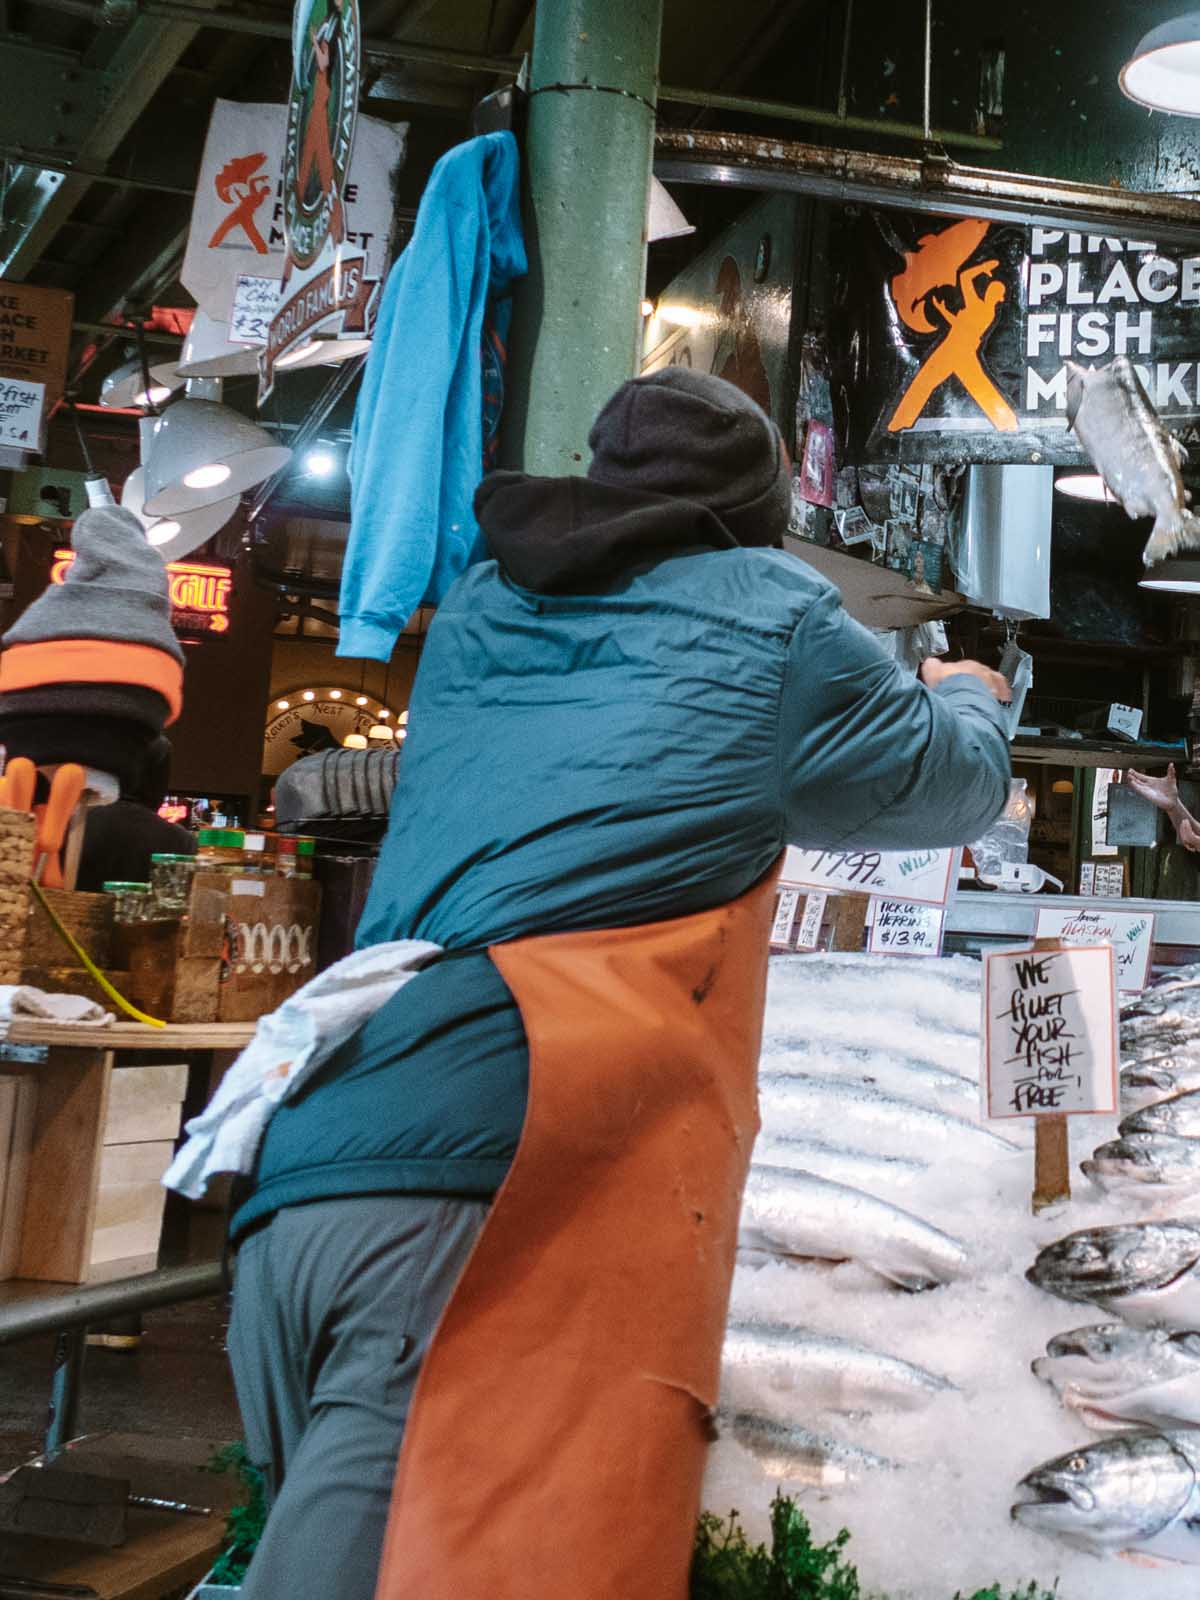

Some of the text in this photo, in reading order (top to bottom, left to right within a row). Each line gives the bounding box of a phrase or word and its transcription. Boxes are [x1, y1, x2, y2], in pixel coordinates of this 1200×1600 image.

[1027, 311, 1153, 358] FISH
[1015, 953, 1062, 990] WE
[1011, 1017, 1076, 1054] YOUR
